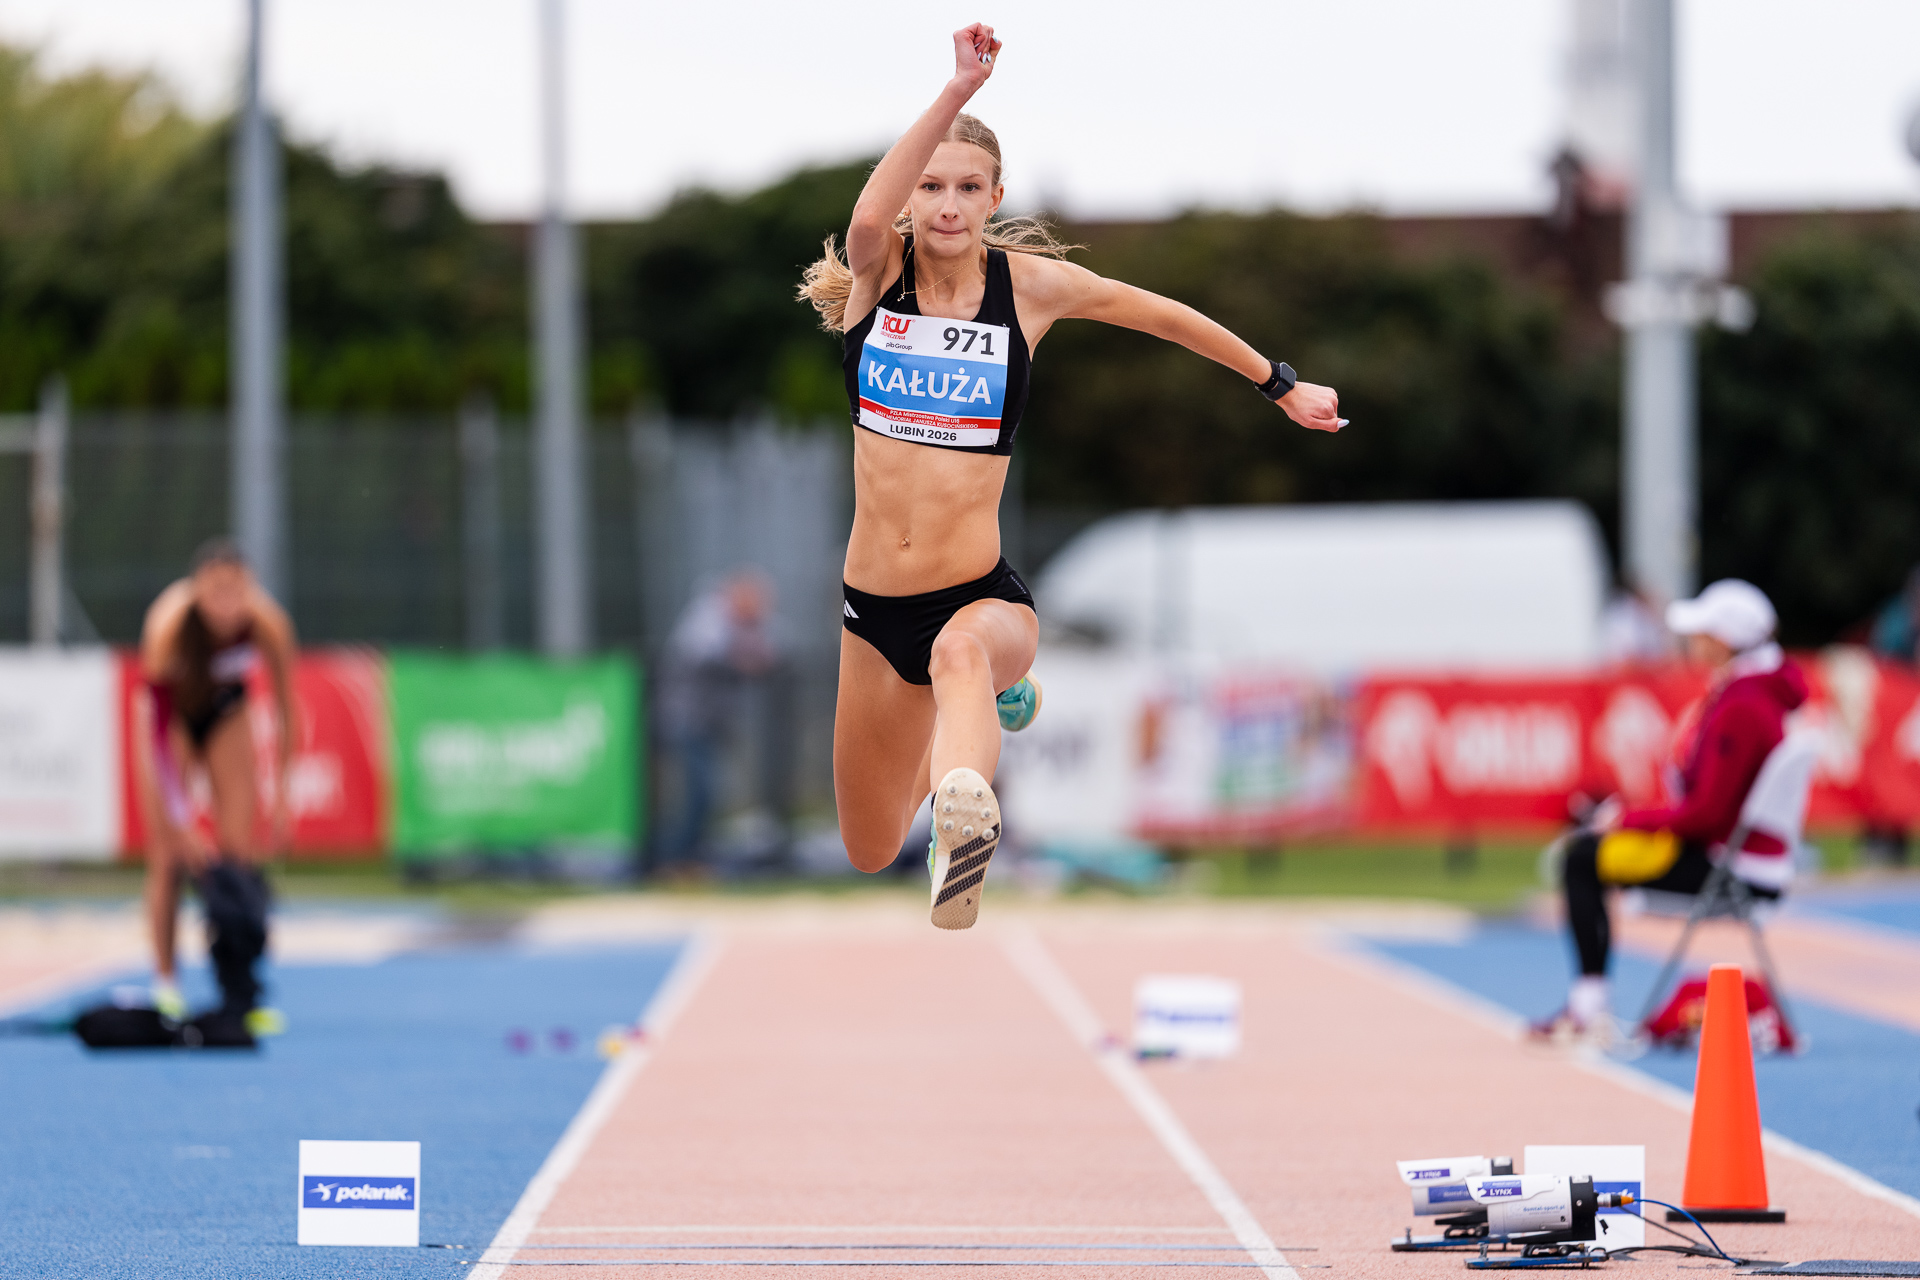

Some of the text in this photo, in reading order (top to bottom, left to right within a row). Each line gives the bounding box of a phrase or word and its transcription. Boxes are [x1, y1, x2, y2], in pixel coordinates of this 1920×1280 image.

[882, 314, 912, 335] RCU
[895, 343, 913, 351] Group
[943, 327, 995, 356] 971
[868, 360, 992, 405] KAŁUŻA
[903, 412, 934, 420] Mistrzostwa
[890, 424, 957, 441] LUBIN 2026
[335, 1183, 408, 1203] polanik
[1490, 1188, 1513, 1196] LYNX
